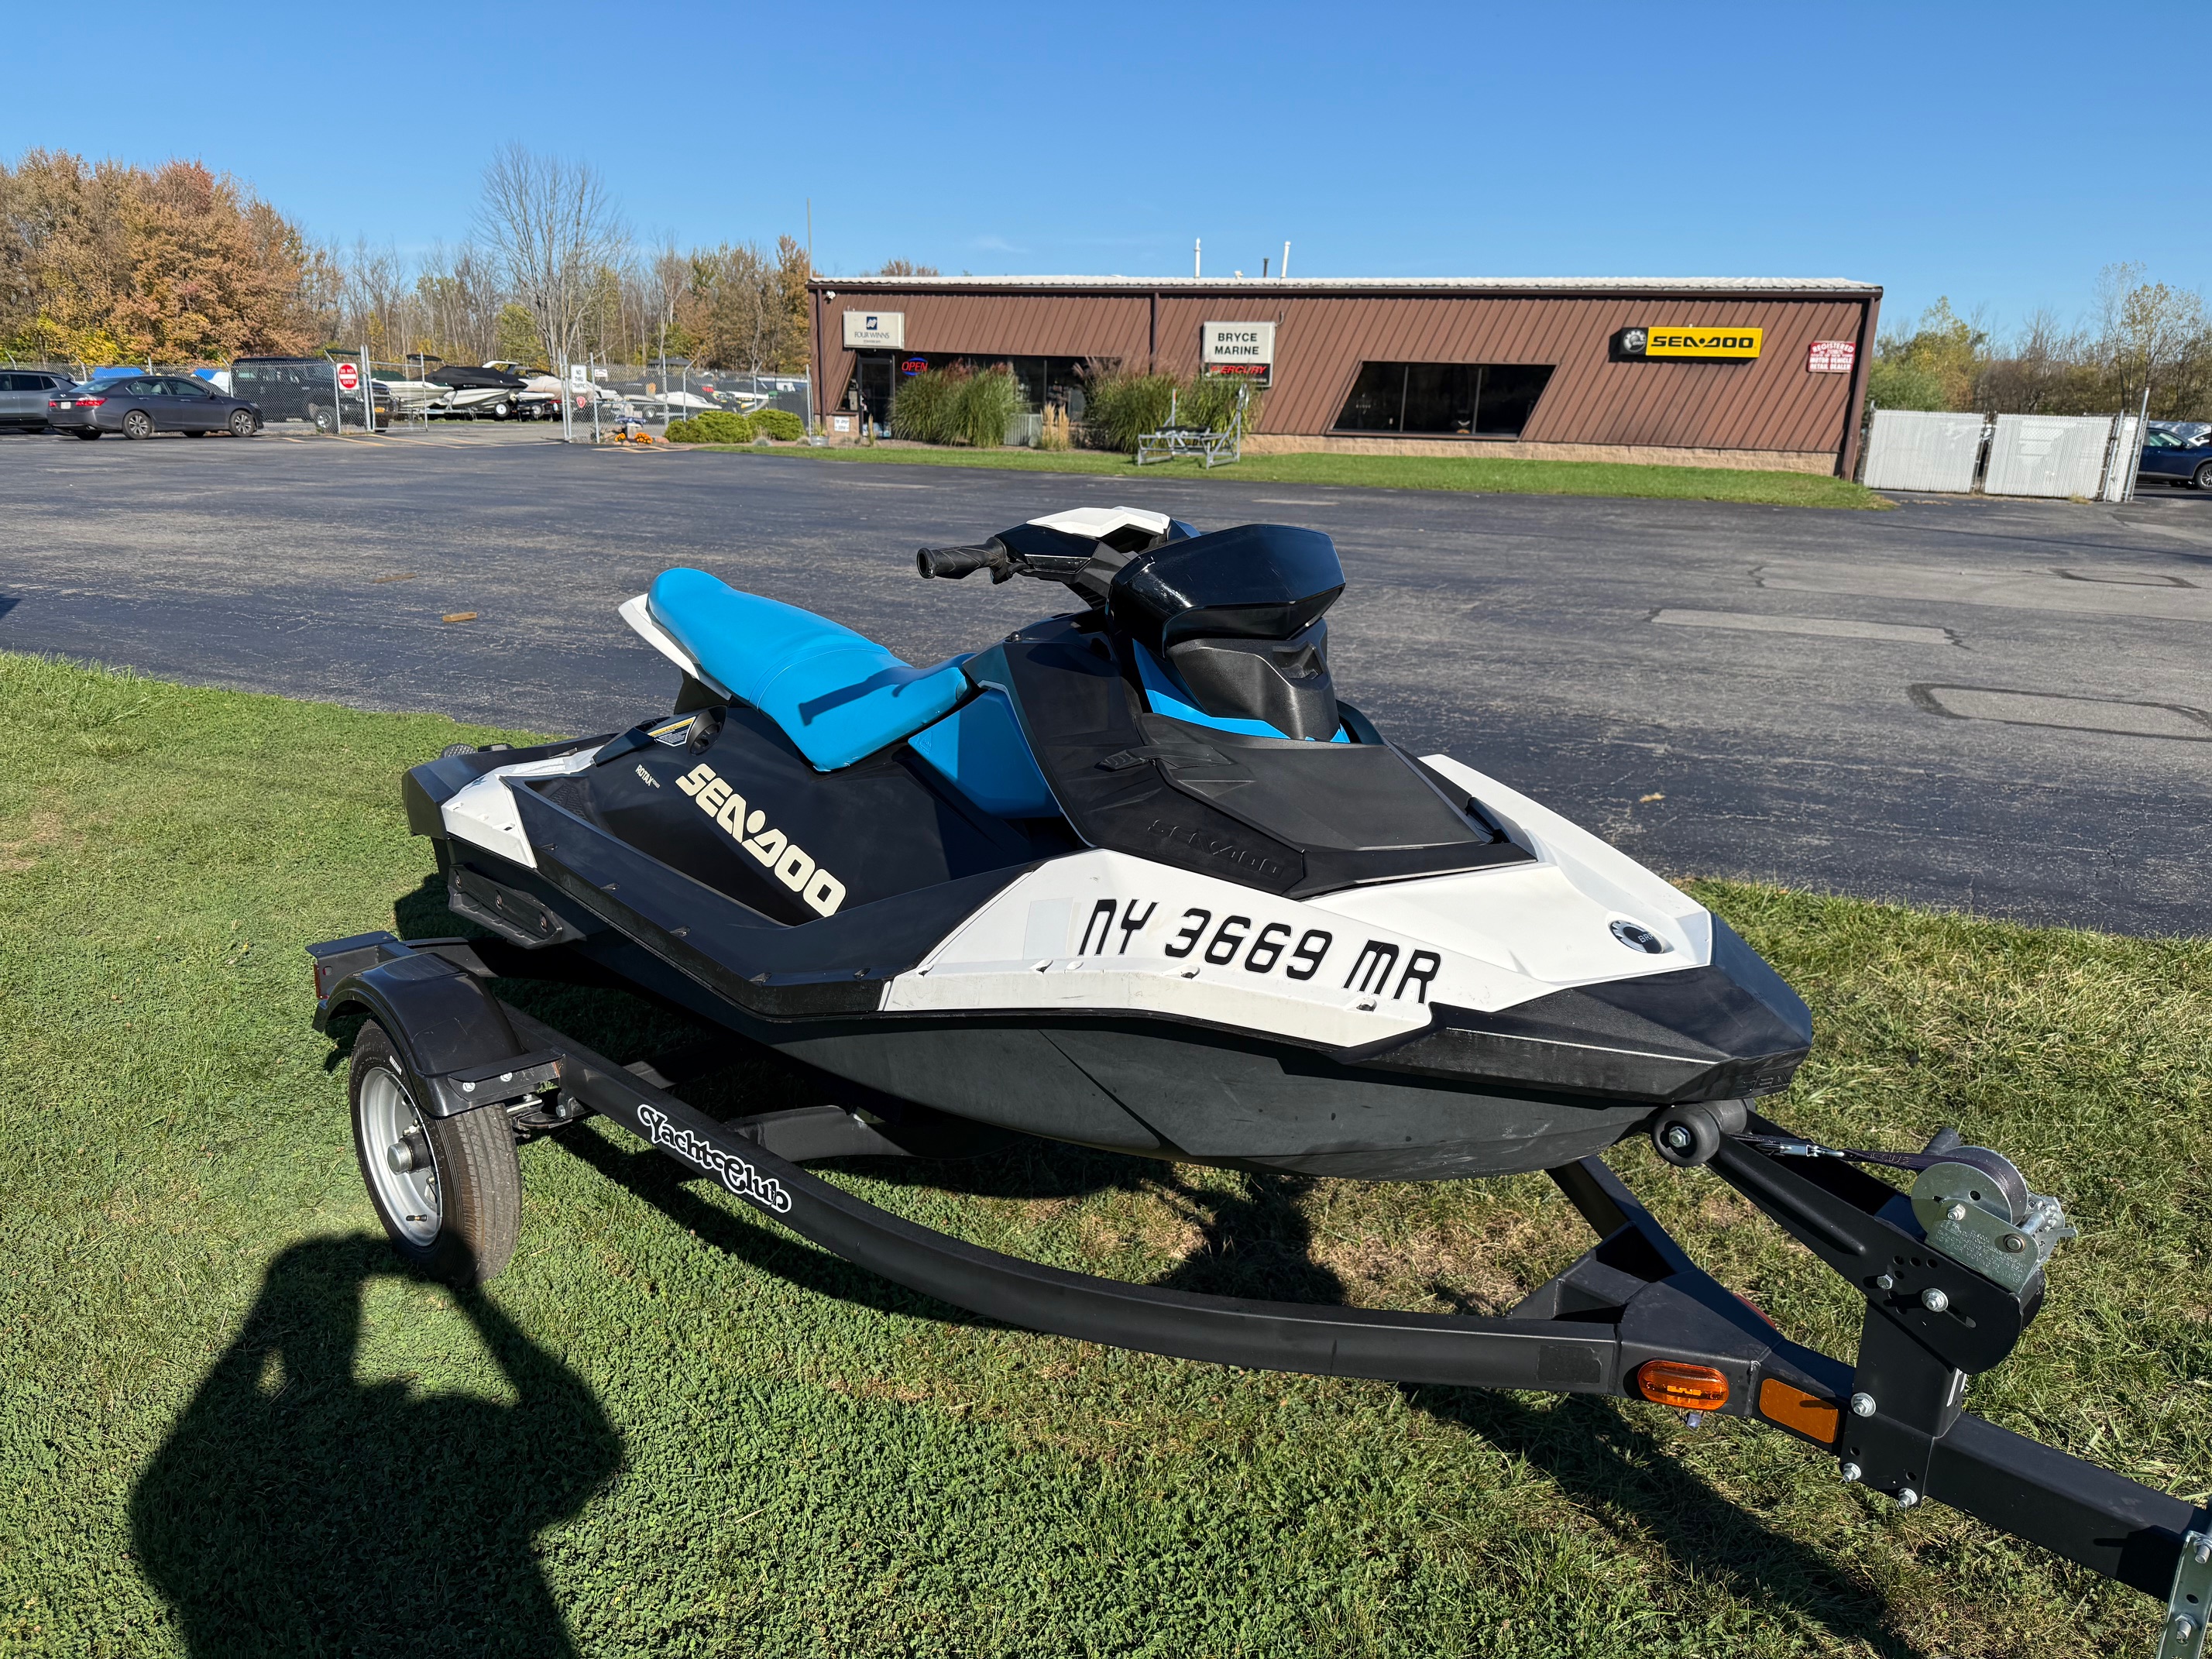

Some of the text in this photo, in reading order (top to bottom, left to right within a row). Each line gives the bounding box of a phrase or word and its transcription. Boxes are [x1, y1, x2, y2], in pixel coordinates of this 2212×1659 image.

[1218, 333, 1257, 342] BRYCE
[1214, 345, 1259, 355] MARINE
[1812, 342, 1854, 353] REGISTERED
[902, 361, 929, 372] OPEN
[635, 764, 654, 786] ROTAX
[1638, 933, 1654, 943] BRP
[1078, 899, 1441, 1005] NY 3669 MR
[1950, 1242, 1963, 1252] FOR
[1965, 1251, 1990, 1266] MOVING
[1992, 1266, 2019, 1283] HUMANS
